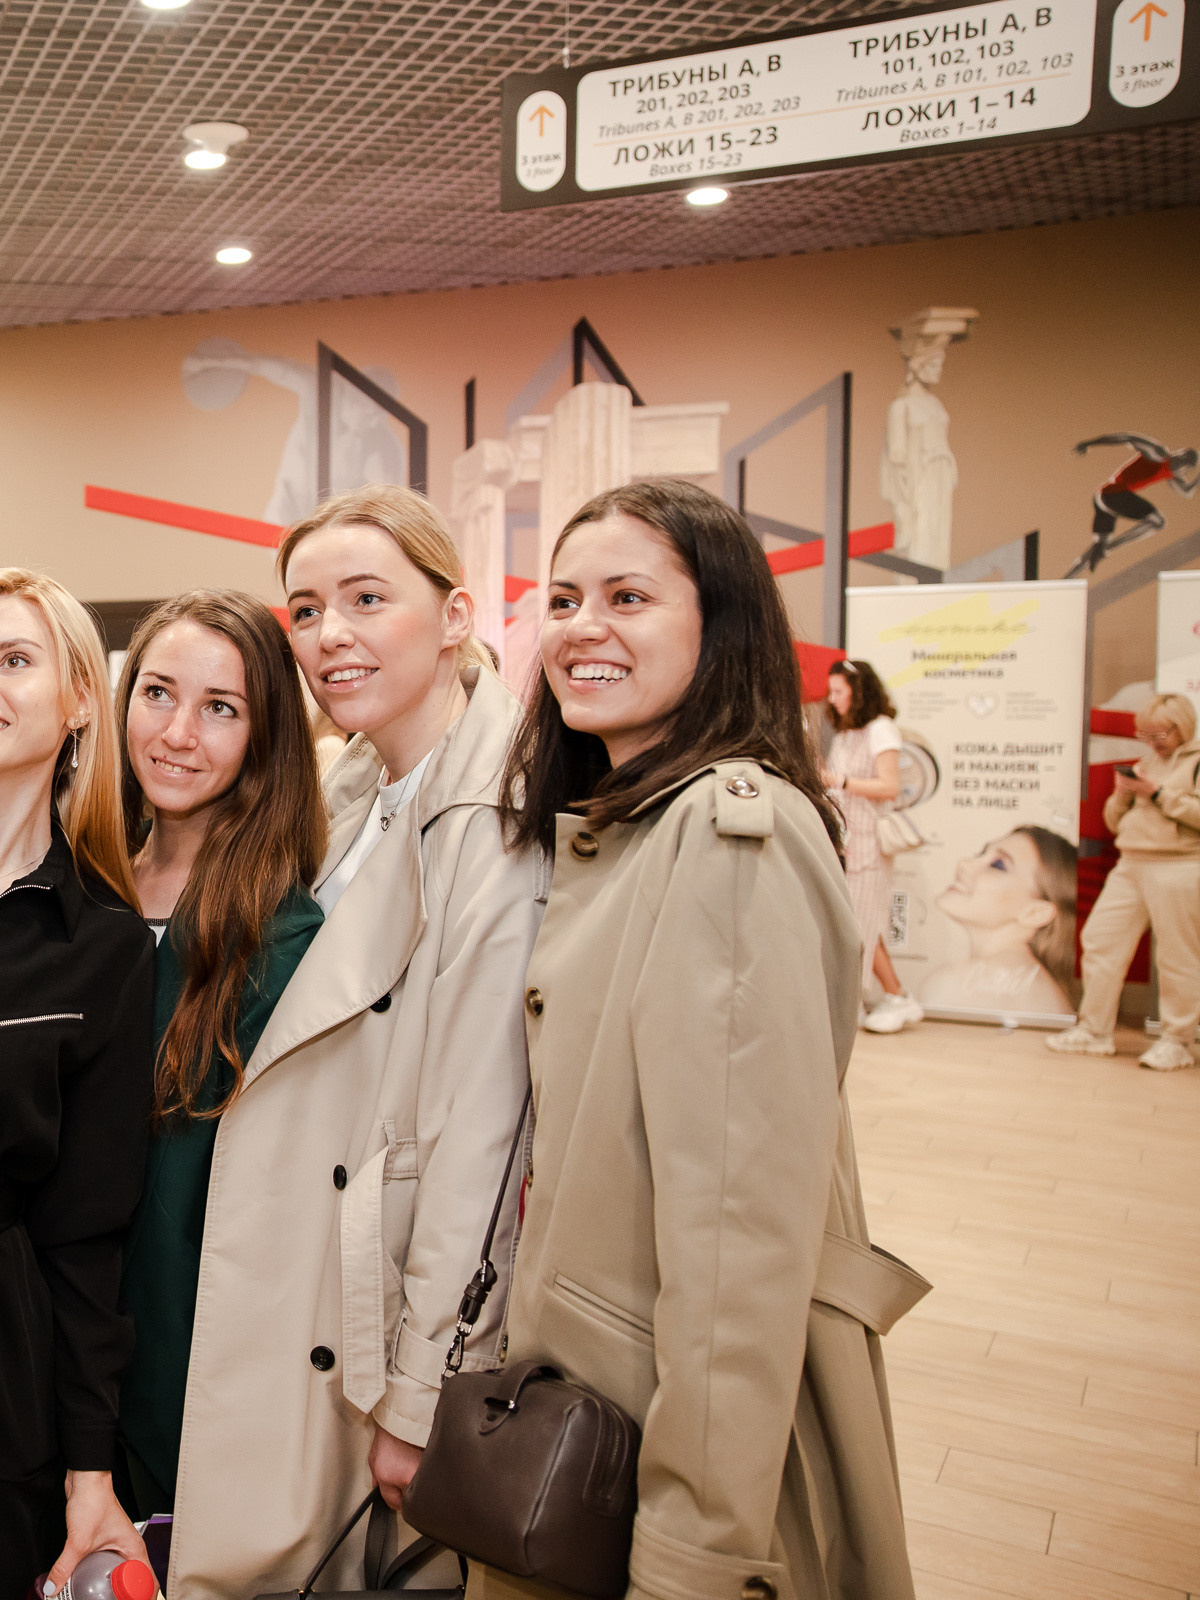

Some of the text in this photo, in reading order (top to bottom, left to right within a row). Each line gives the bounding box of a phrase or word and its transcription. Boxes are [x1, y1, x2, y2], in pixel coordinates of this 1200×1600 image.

[849, 17, 987, 58] ТРИБУНЫ
[1035, 7, 1052, 27] В
[882, 41, 1015, 75] 101, 102, 103
[608, 64, 728, 98] ТРИБУНЫ
[767, 54, 782, 73] В
[836, 77, 907, 103] Tribunes
[953, 67, 987, 85] 101,
[997, 60, 1031, 77] 102,
[1041, 53, 1074, 71] 103
[1116, 59, 1176, 79] 3 этаж
[1132, 76, 1165, 95] floor
[636, 83, 751, 115] 201, 202, 203
[598, 115, 661, 139] Tribunes
[697, 108, 730, 126] 201,
[734, 101, 768, 120] 202,
[771, 95, 801, 113] 203
[861, 99, 957, 132] ЛОЖИ
[899, 124, 950, 144] Boxes
[613, 137, 694, 167] ЛОЖИ
[650, 159, 693, 178] Boxes
[911, 649, 1018, 664] Минеральная
[923, 668, 1004, 679] косметика
[954, 742, 1066, 757] КОЖА ДЫШИТ
[953, 778, 1041, 792] БЕЗ МАСКИ
[952, 796, 1020, 811] НА ЛИЦЕ
